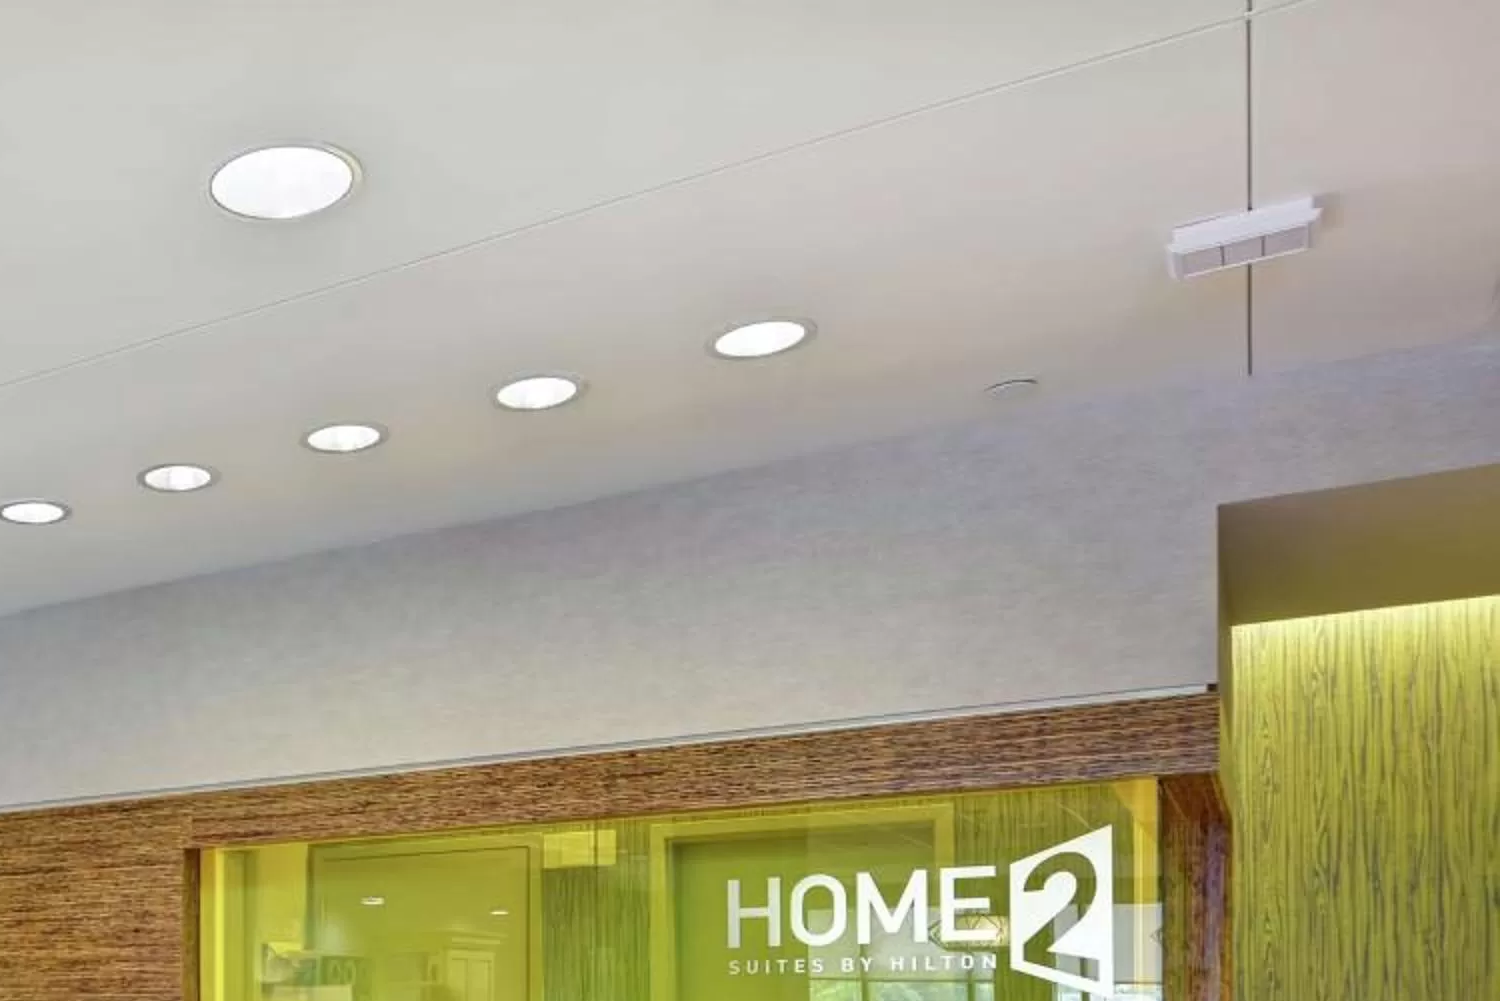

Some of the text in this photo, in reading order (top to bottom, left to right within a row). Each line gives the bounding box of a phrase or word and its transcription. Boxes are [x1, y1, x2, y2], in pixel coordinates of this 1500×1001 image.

[729, 955, 997, 975] SUITES BY HILTON
